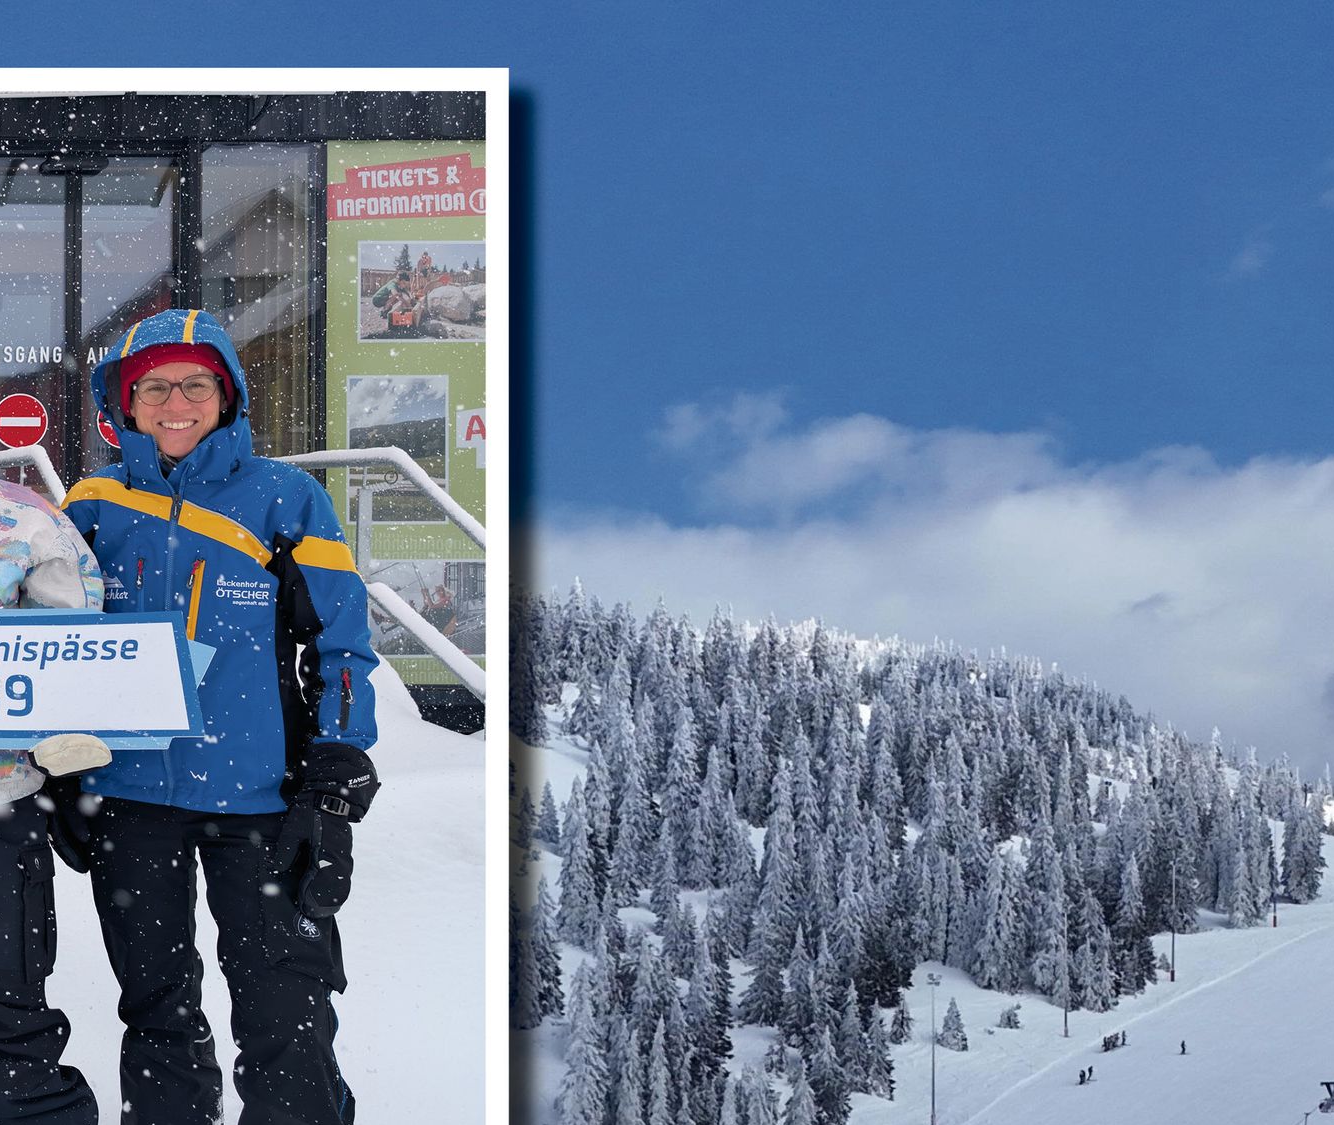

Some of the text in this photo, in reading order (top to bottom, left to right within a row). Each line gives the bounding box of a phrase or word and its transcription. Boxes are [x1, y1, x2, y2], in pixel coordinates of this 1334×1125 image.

[357, 165, 460, 189] TICKETS &
[105, 589, 129, 600] chkar
[215, 587, 269, 600] ÖTSCHER
